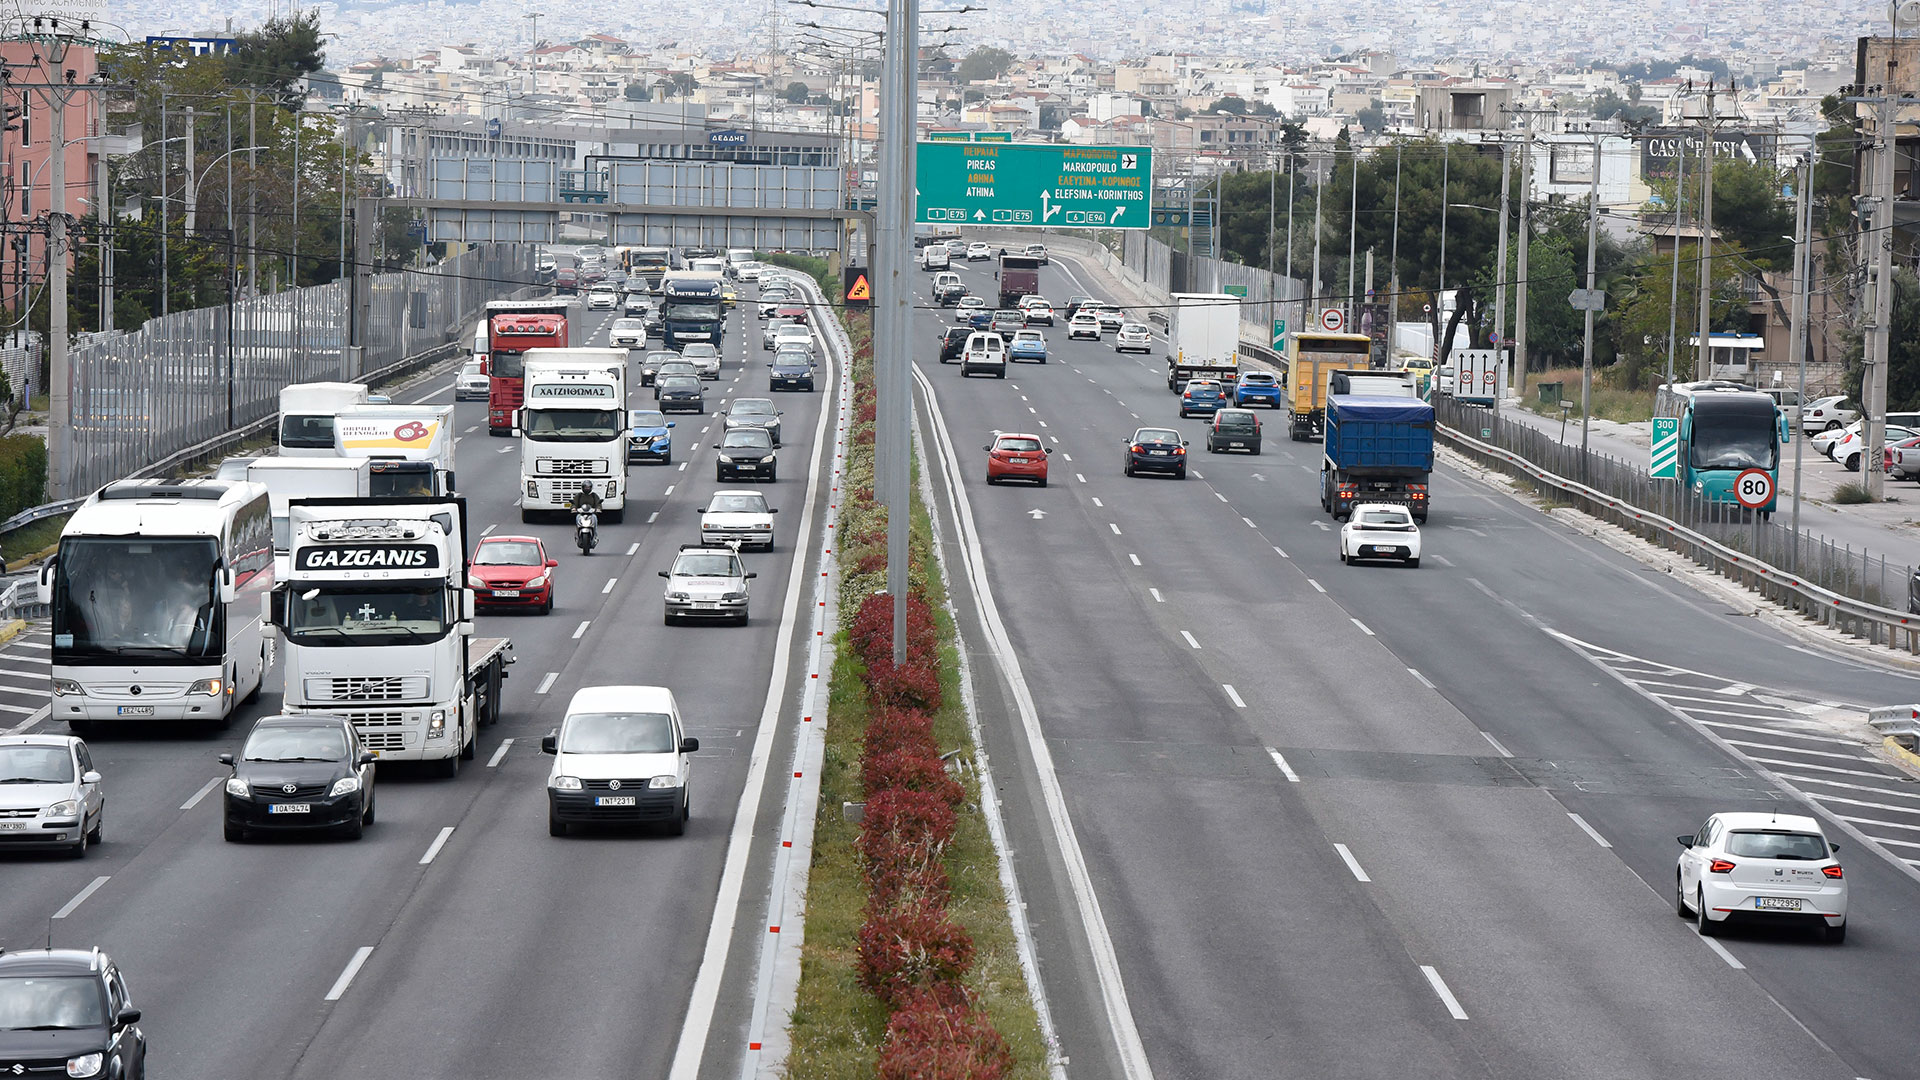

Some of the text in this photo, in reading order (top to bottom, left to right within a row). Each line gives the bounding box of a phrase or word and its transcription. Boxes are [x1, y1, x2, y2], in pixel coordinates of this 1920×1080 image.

[964, 146, 999, 157] ΠΕΙΡΑΙΑΣ
[1649, 138, 1684, 158] CASA
[967, 159, 996, 170] PIREAS
[1062, 162, 1117, 173] MARKOPOULO
[967, 173, 994, 183] ΑΘΗΝΑ
[966, 186, 995, 197] ATHINA
[1462, 373, 1472, 381] 100
[1656, 420, 1674, 430] 300
[1742, 479, 1766, 496] 80
[306, 549, 427, 568] GAZGANIS
